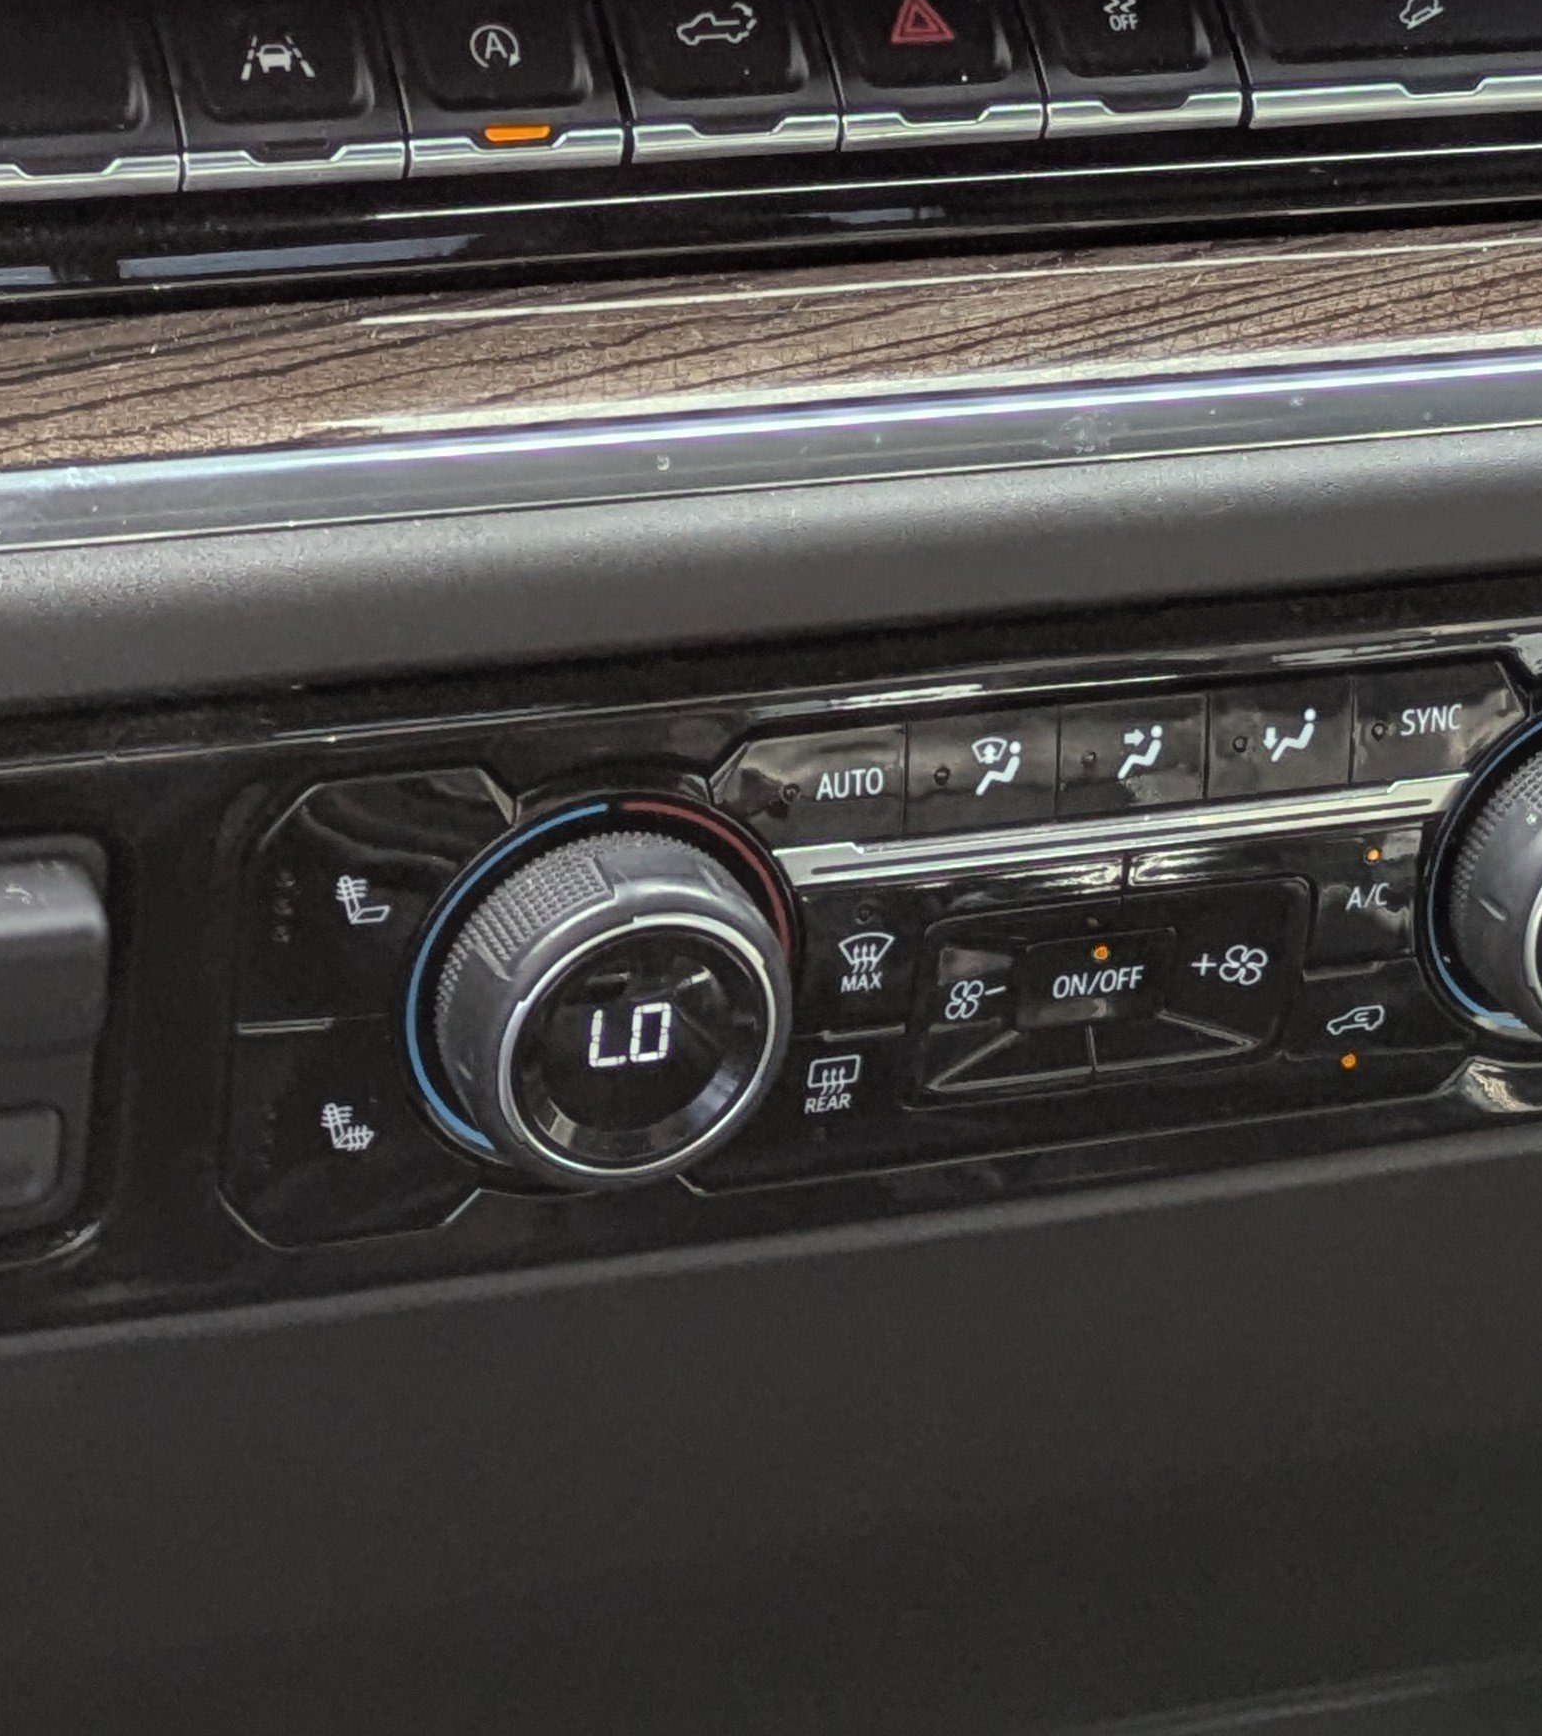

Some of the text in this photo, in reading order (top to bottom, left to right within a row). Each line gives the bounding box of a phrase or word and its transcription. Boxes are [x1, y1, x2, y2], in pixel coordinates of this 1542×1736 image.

[1109, 13, 1139, 32] OFF
[1400, 702, 1462, 736] SYNC
[815, 767, 883, 801] AUTO
[1345, 882, 1389, 911] A/C
[840, 971, 884, 994] MAX
[1052, 965, 1145, 999] ON/OFF
[804, 1092, 852, 1115] REAR
